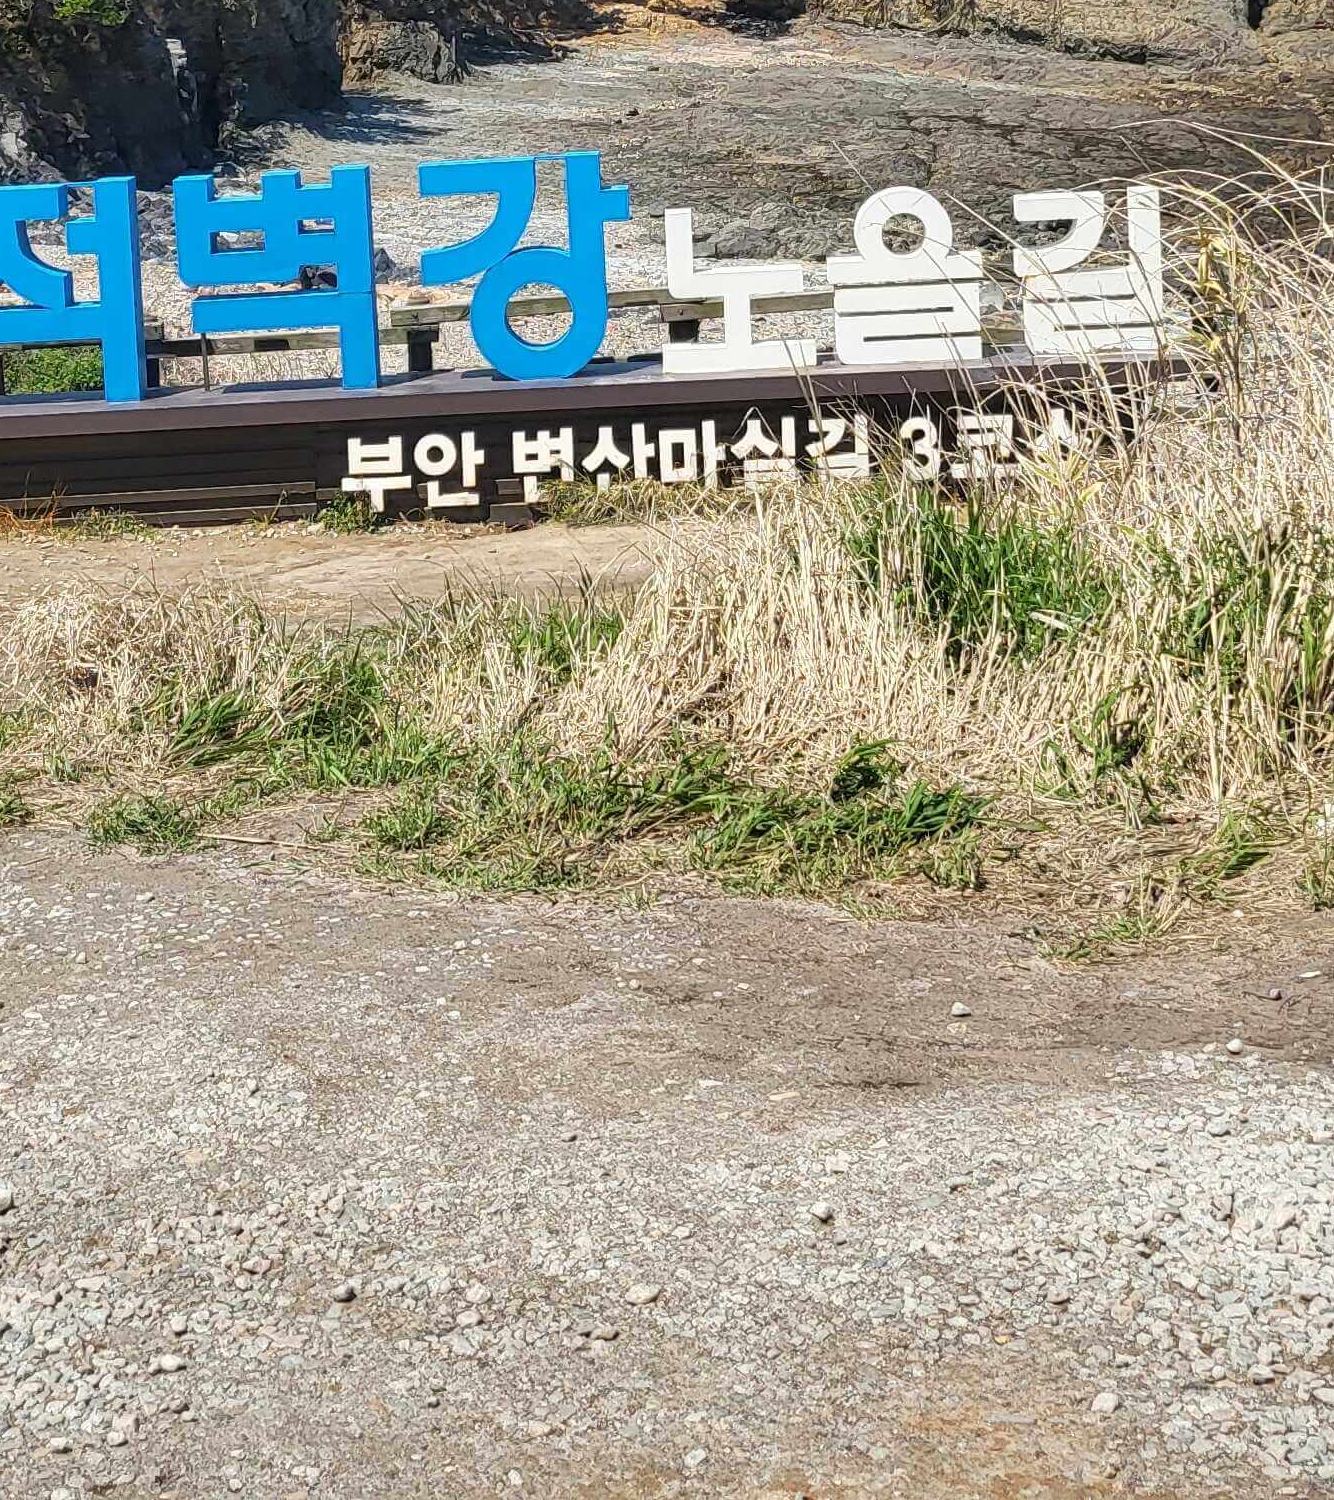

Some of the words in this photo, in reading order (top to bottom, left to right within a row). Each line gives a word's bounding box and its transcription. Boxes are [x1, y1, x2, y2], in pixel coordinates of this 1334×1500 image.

[662, 185, 1164, 374] 노을길
[341, 431, 486, 513] 부안
[512, 414, 871, 504] 변산마실길
